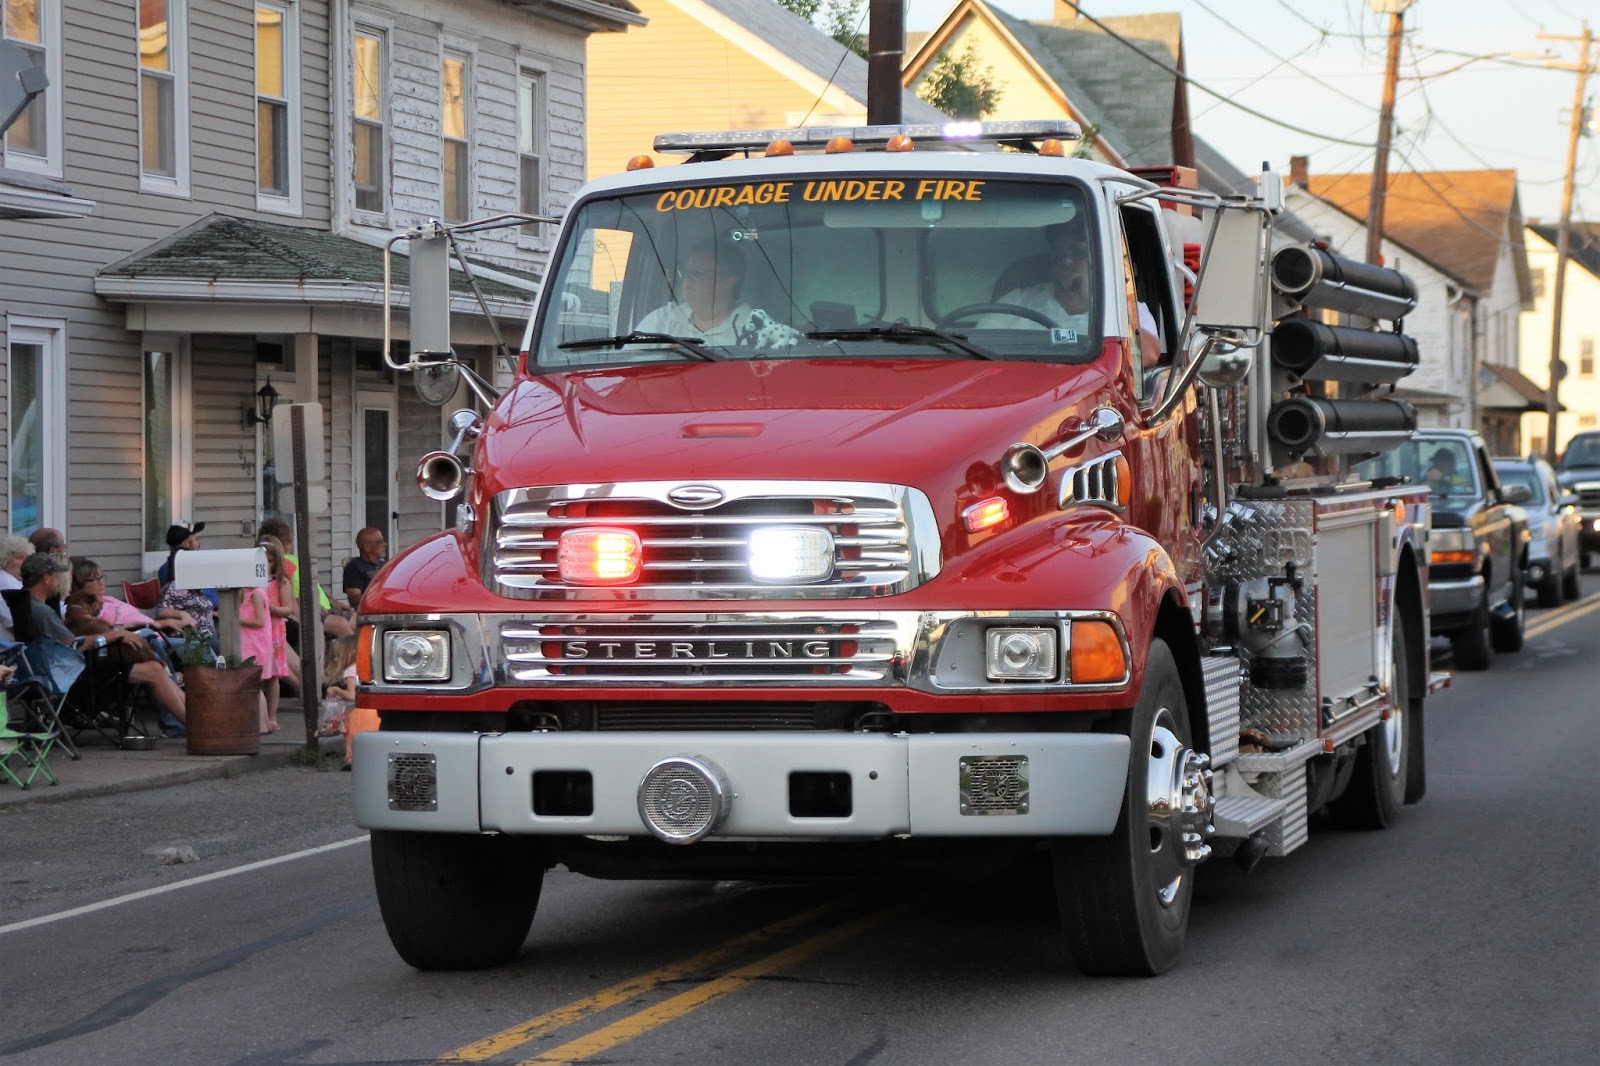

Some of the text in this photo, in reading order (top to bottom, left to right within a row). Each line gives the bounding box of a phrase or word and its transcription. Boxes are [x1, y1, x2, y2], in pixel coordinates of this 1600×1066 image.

[656, 181, 985, 212] COURAGE UNDER FIRE
[565, 641, 830, 659] STERLING
